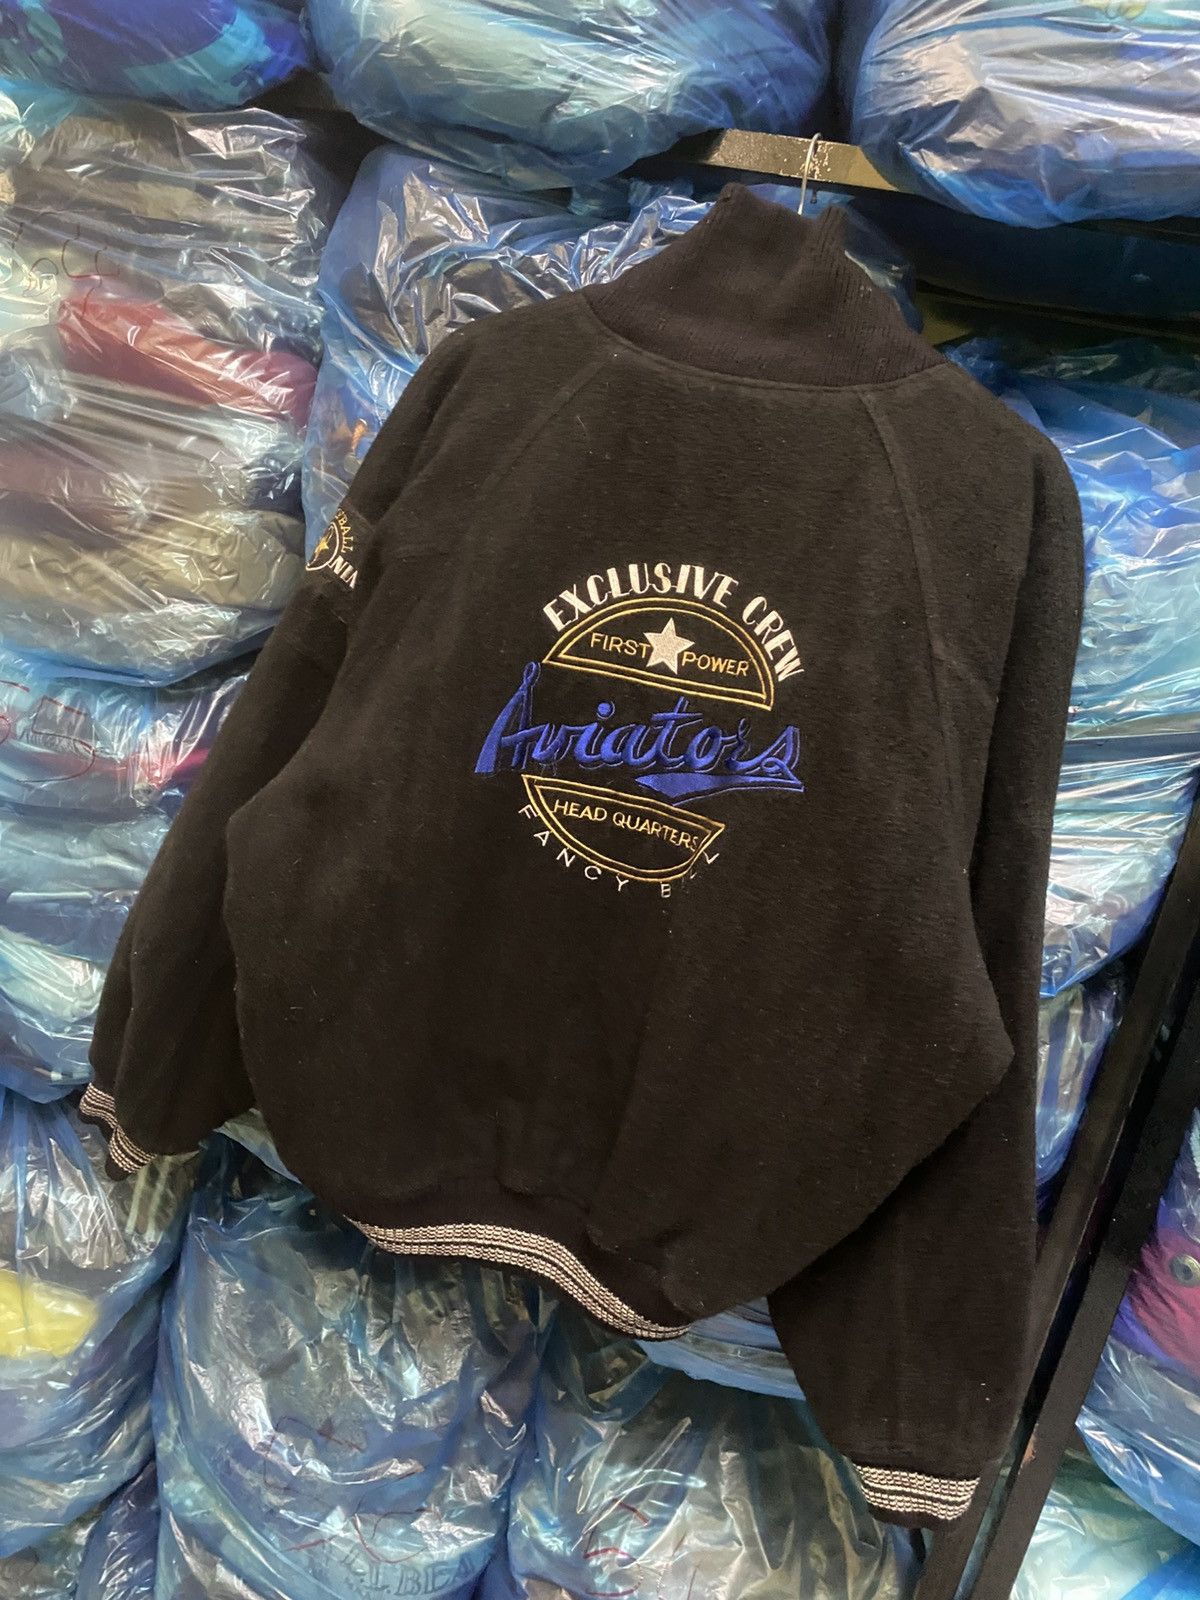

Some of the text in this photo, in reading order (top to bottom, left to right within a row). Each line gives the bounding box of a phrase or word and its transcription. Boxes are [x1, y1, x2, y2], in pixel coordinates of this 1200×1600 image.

[542, 562, 805, 682] EXCLUSIVE CREW
[590, 632, 749, 677] FIRST POWER
[474, 661, 805, 794] Aviators
[518, 803, 630, 892] FANCY
[553, 799, 699, 853] HEAD QUARTERS
